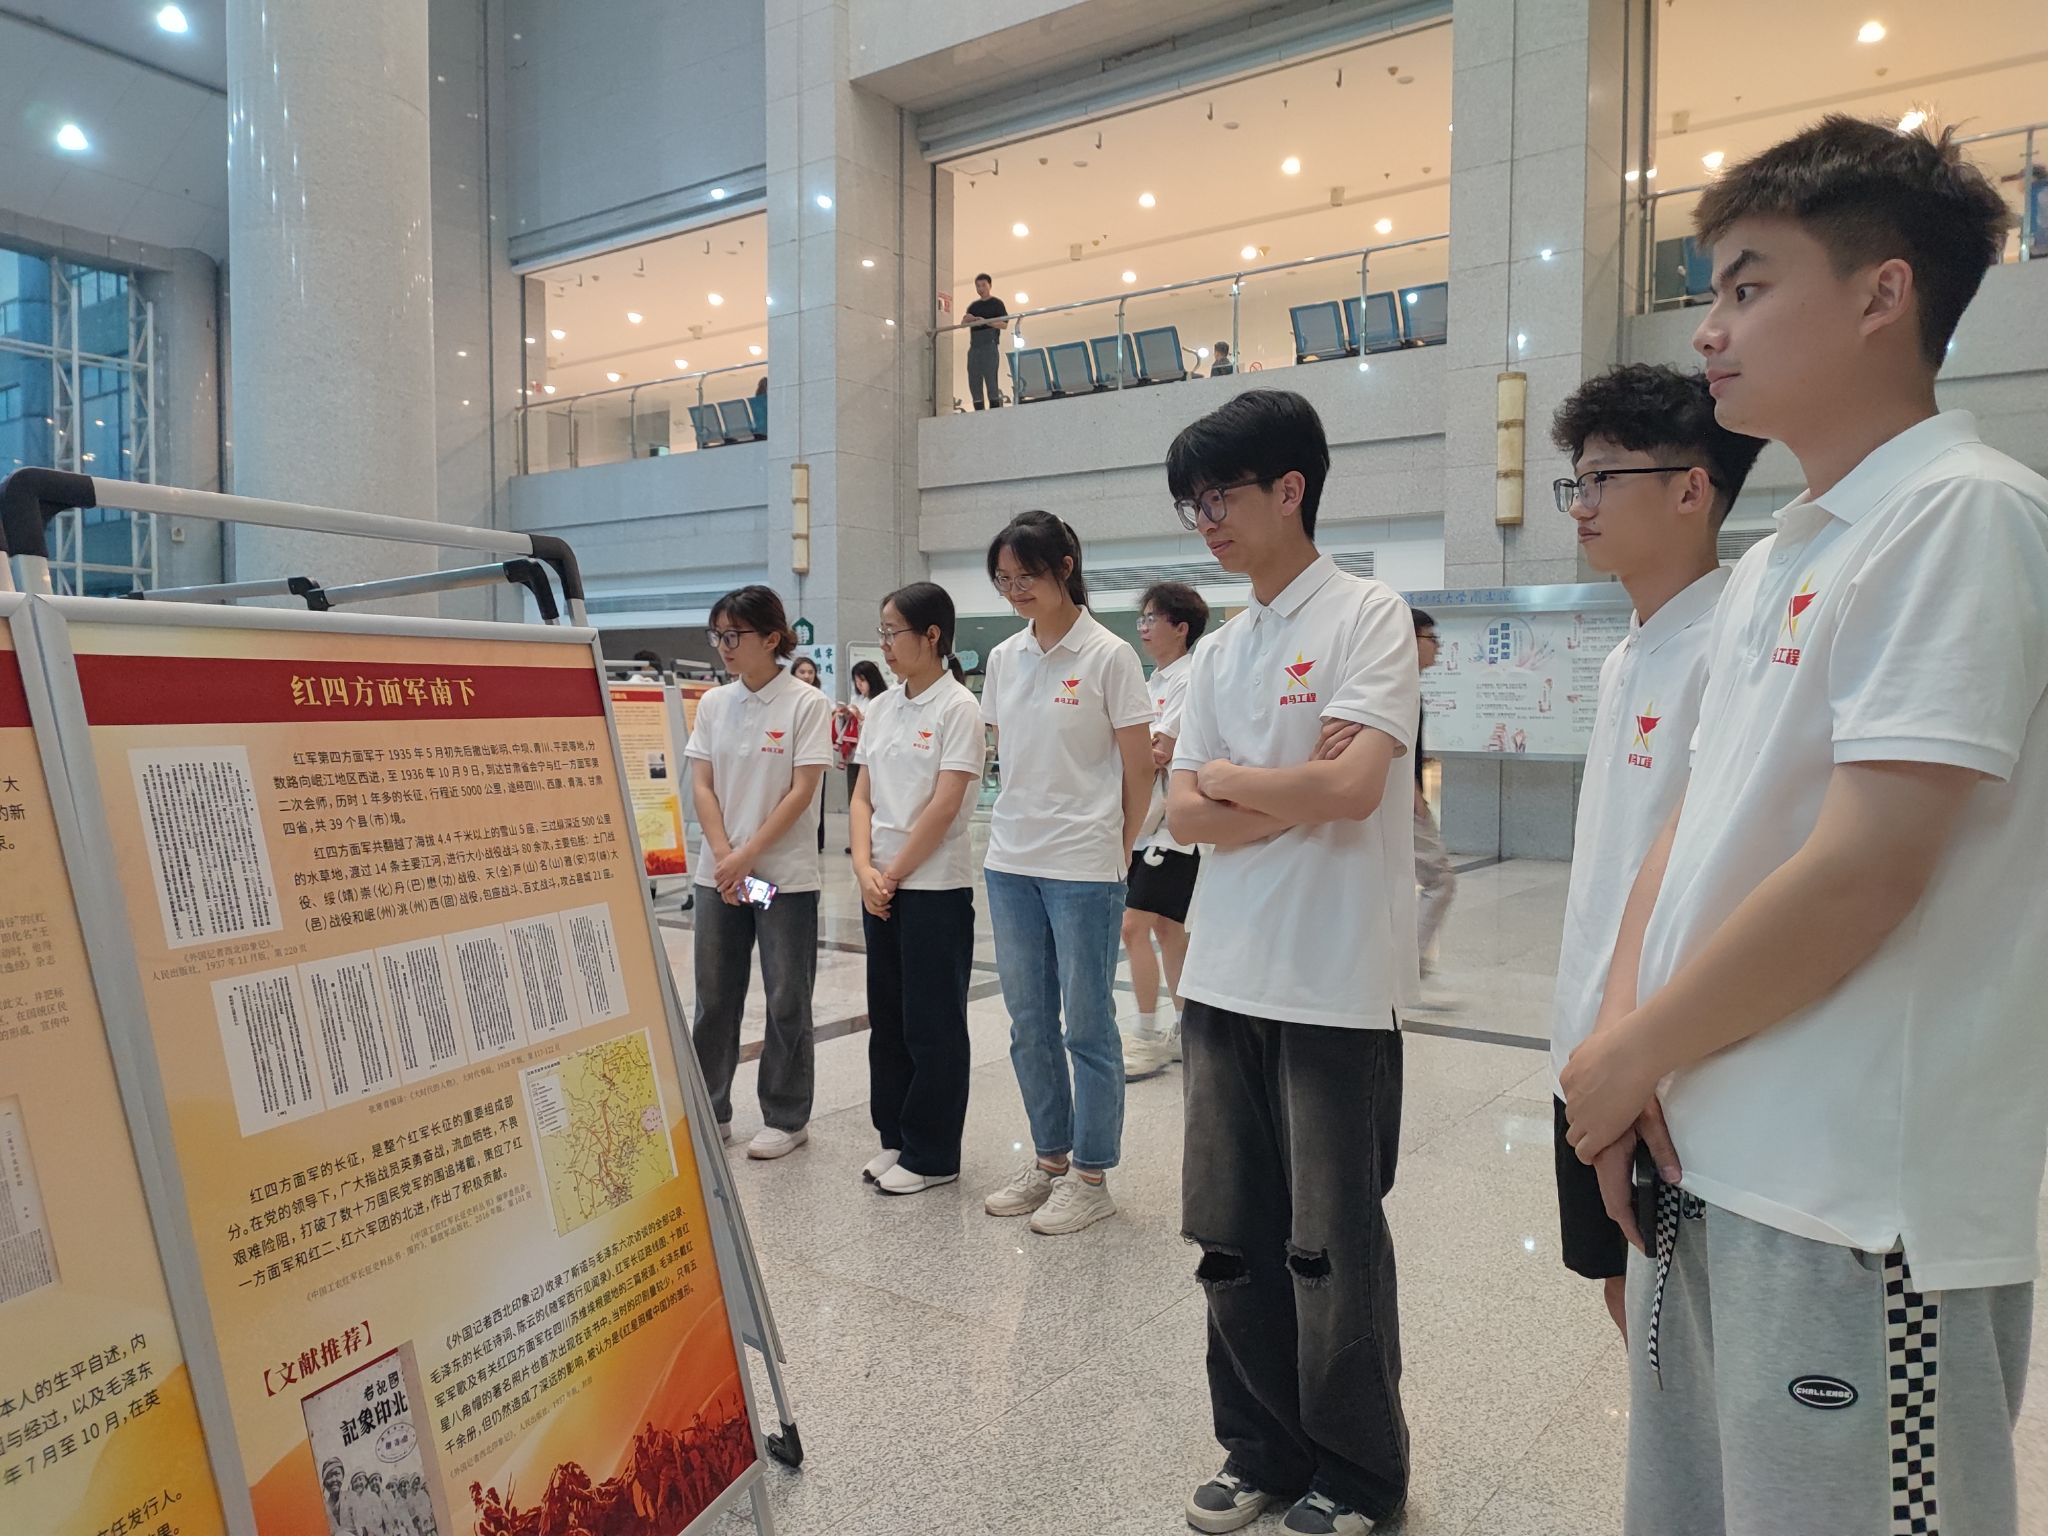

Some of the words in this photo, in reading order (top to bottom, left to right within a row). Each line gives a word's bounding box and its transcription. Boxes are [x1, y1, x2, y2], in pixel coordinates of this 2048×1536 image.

[290, 675, 476, 707] 红四方面军南下
[1628, 753, 1653, 769] 马工程
[249, 1094, 514, 1204] 红四方面军的长征，是整个红军长征的重要组成部
[1796, 1387, 1851, 1398] CHALLENGE
